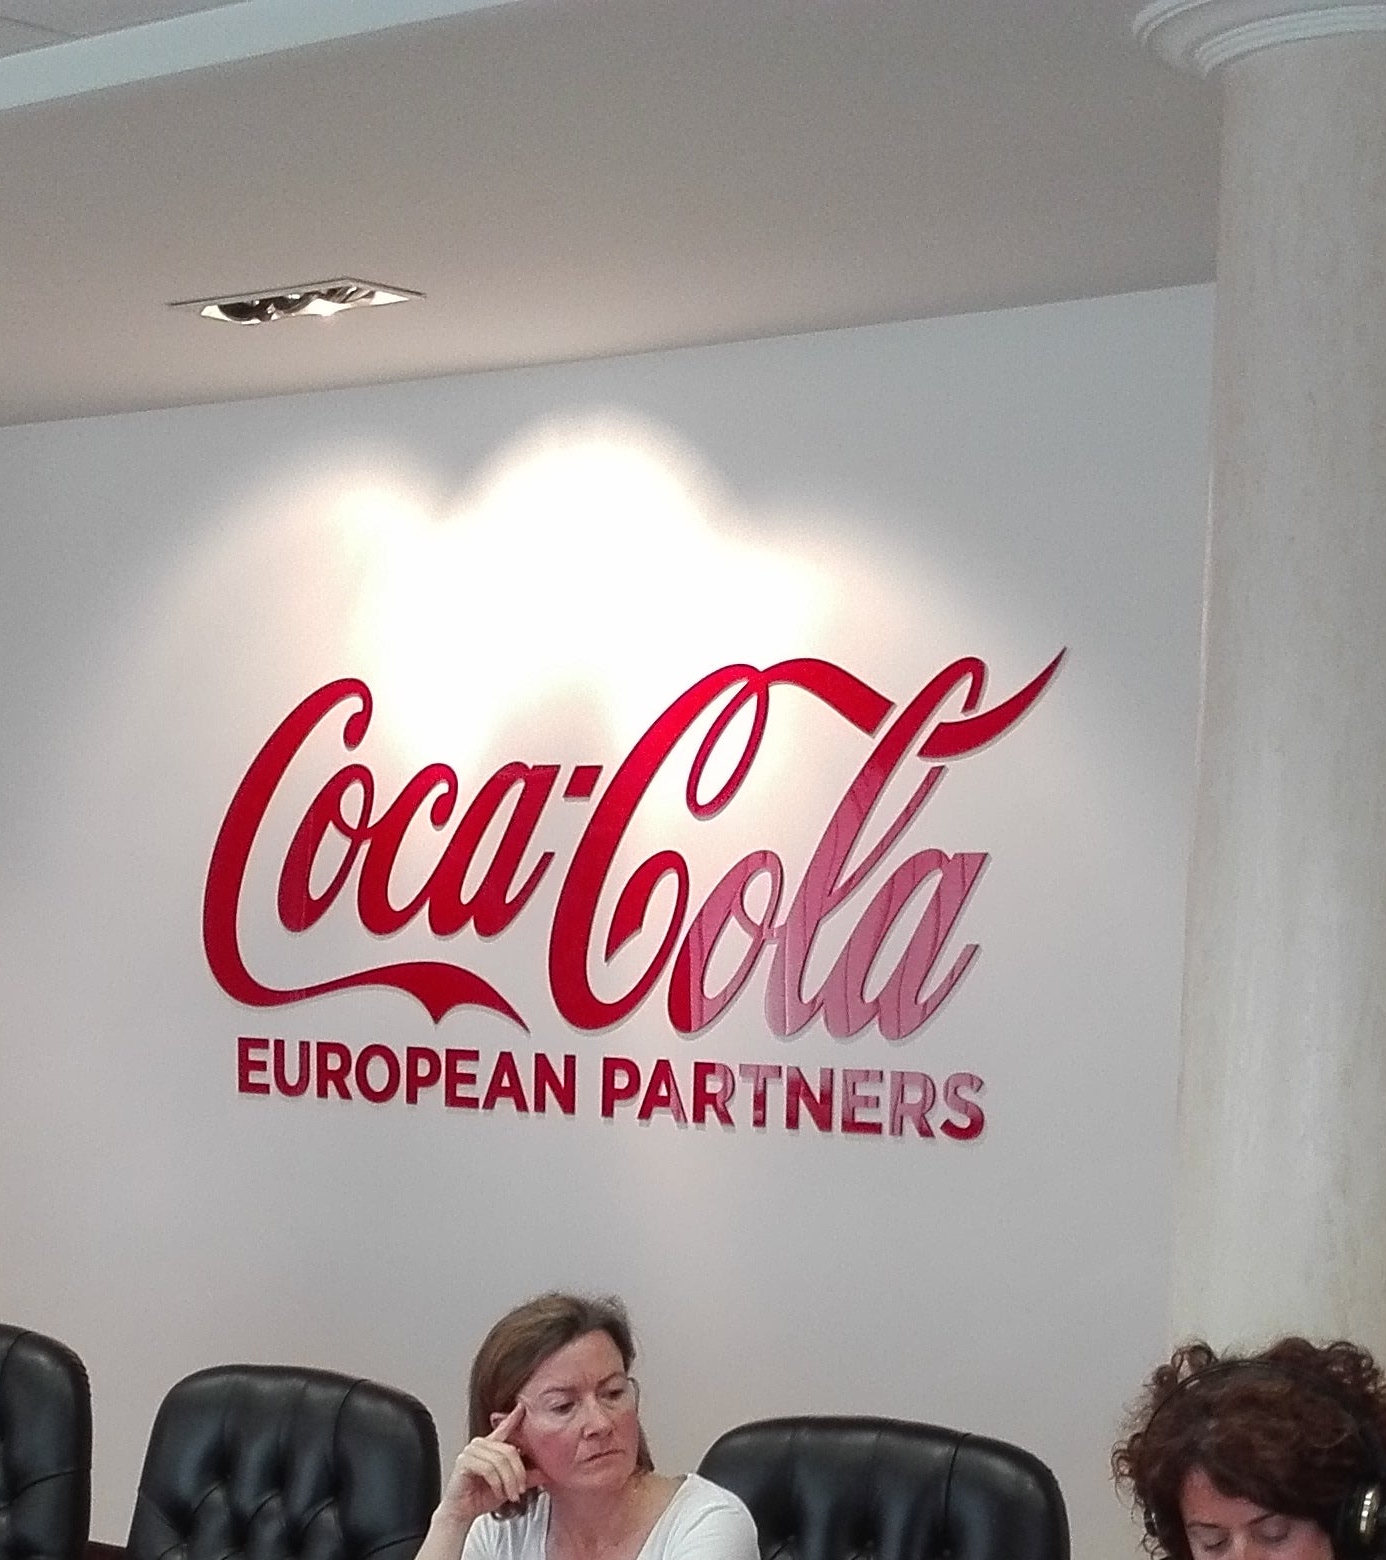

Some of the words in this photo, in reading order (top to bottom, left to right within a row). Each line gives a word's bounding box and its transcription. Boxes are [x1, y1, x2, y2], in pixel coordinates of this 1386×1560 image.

[203, 647, 1067, 1040] Coca-Cola
[237, 1037, 576, 1114] EUROPEAN
[602, 1058, 985, 1140] PARTNERS
